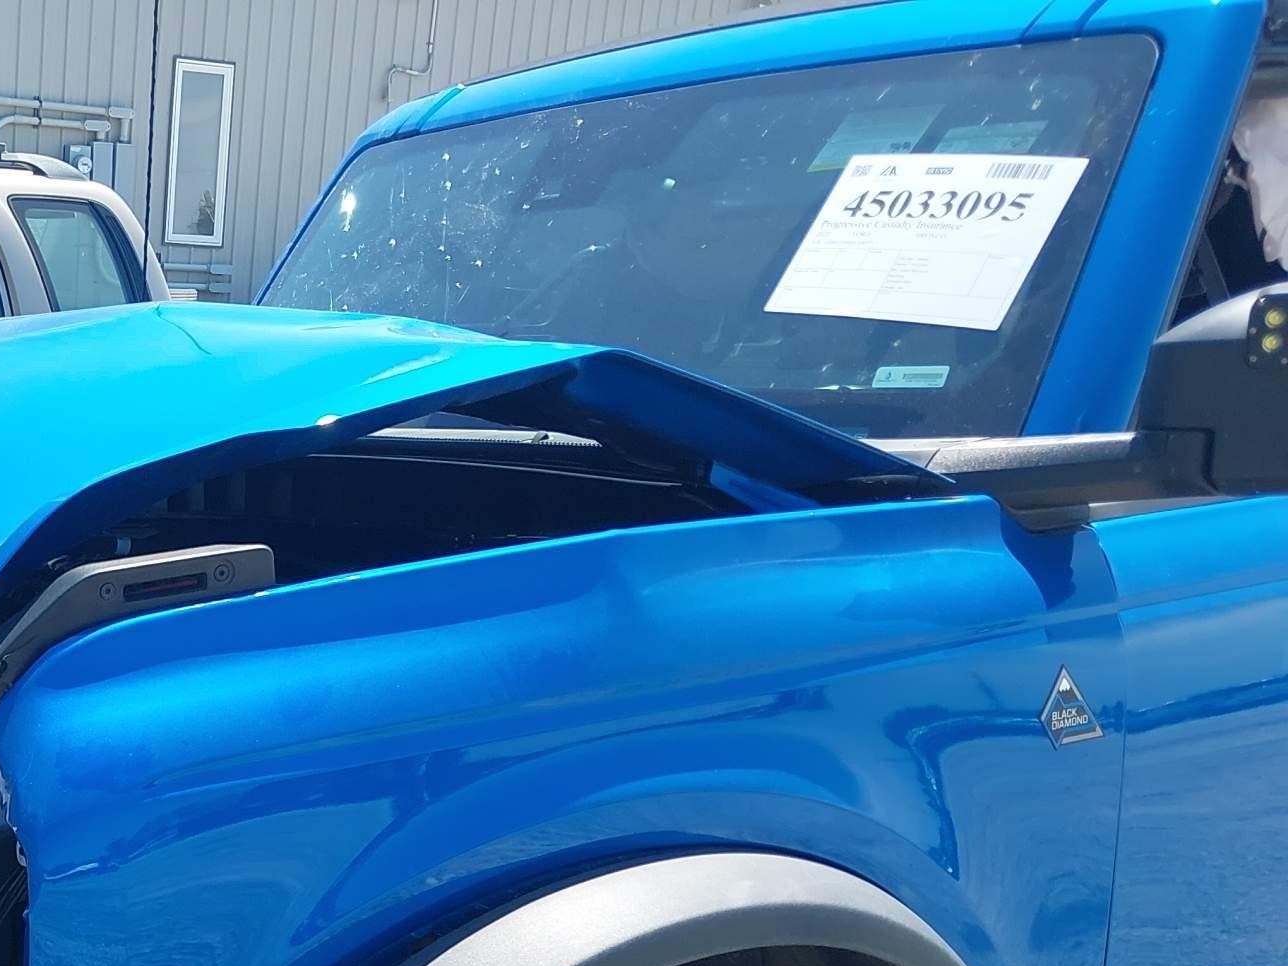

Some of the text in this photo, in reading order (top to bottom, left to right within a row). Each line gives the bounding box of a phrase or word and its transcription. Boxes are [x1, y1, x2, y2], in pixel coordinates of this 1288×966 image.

[843, 191, 1034, 221] 45033095
[915, 220, 964, 231] Insurance
[1051, 708, 1078, 721] BLACK
[1051, 714, 1089, 730] DIAMOND
